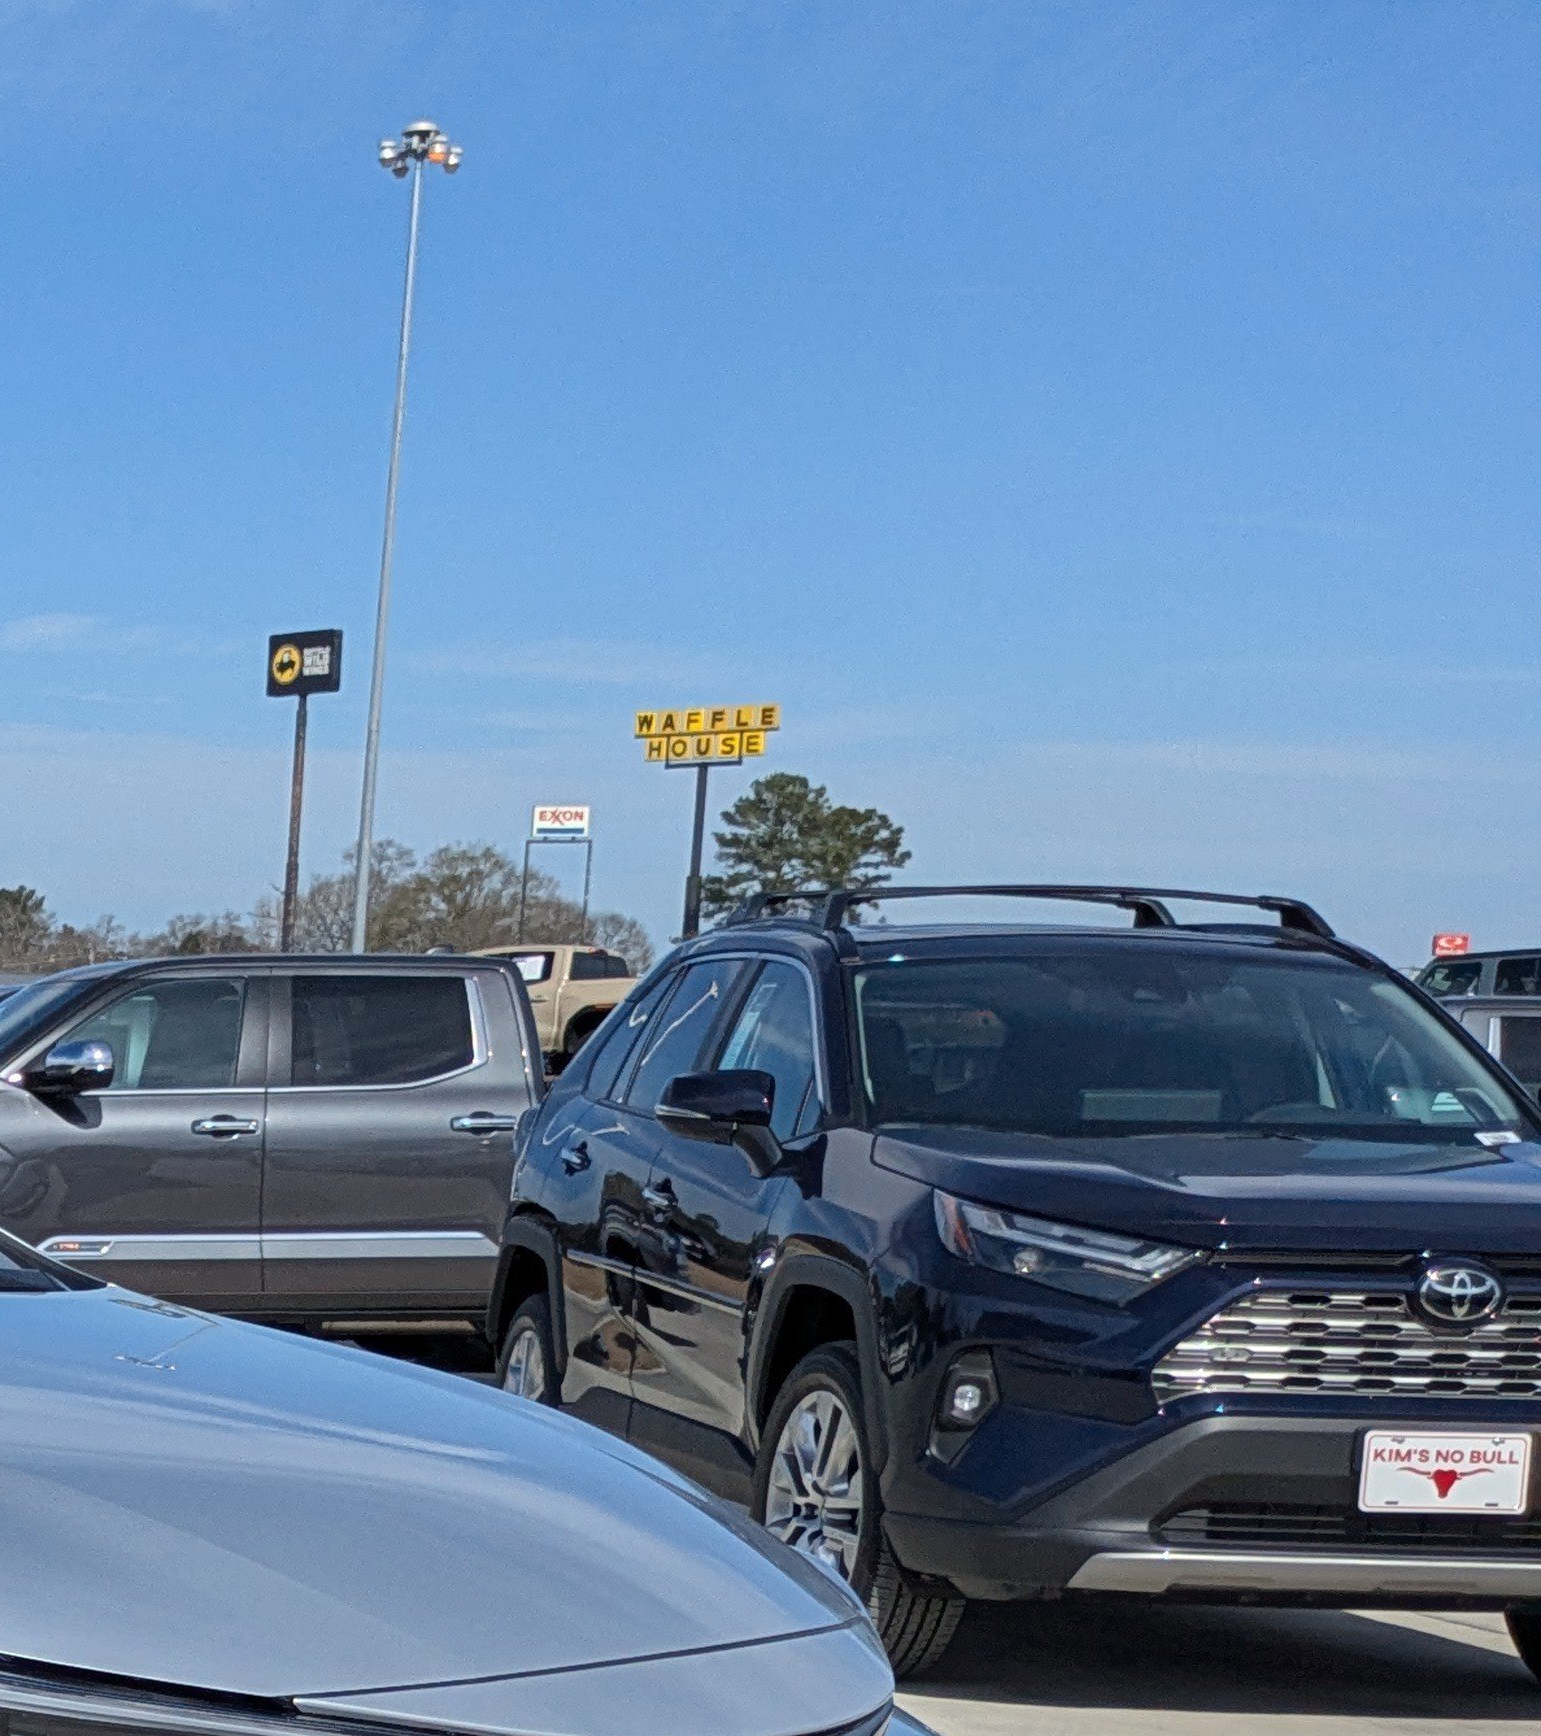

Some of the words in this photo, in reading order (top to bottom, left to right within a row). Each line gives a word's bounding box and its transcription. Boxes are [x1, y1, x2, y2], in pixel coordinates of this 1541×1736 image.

[637, 707, 775, 733] WAFFLE
[648, 735, 760, 758] HOUSE
[538, 809, 584, 826] EXXON
[1373, 1448, 1430, 1463] KIM'S
[1435, 1449, 1464, 1463] NO
[1469, 1450, 1519, 1465] BULL
